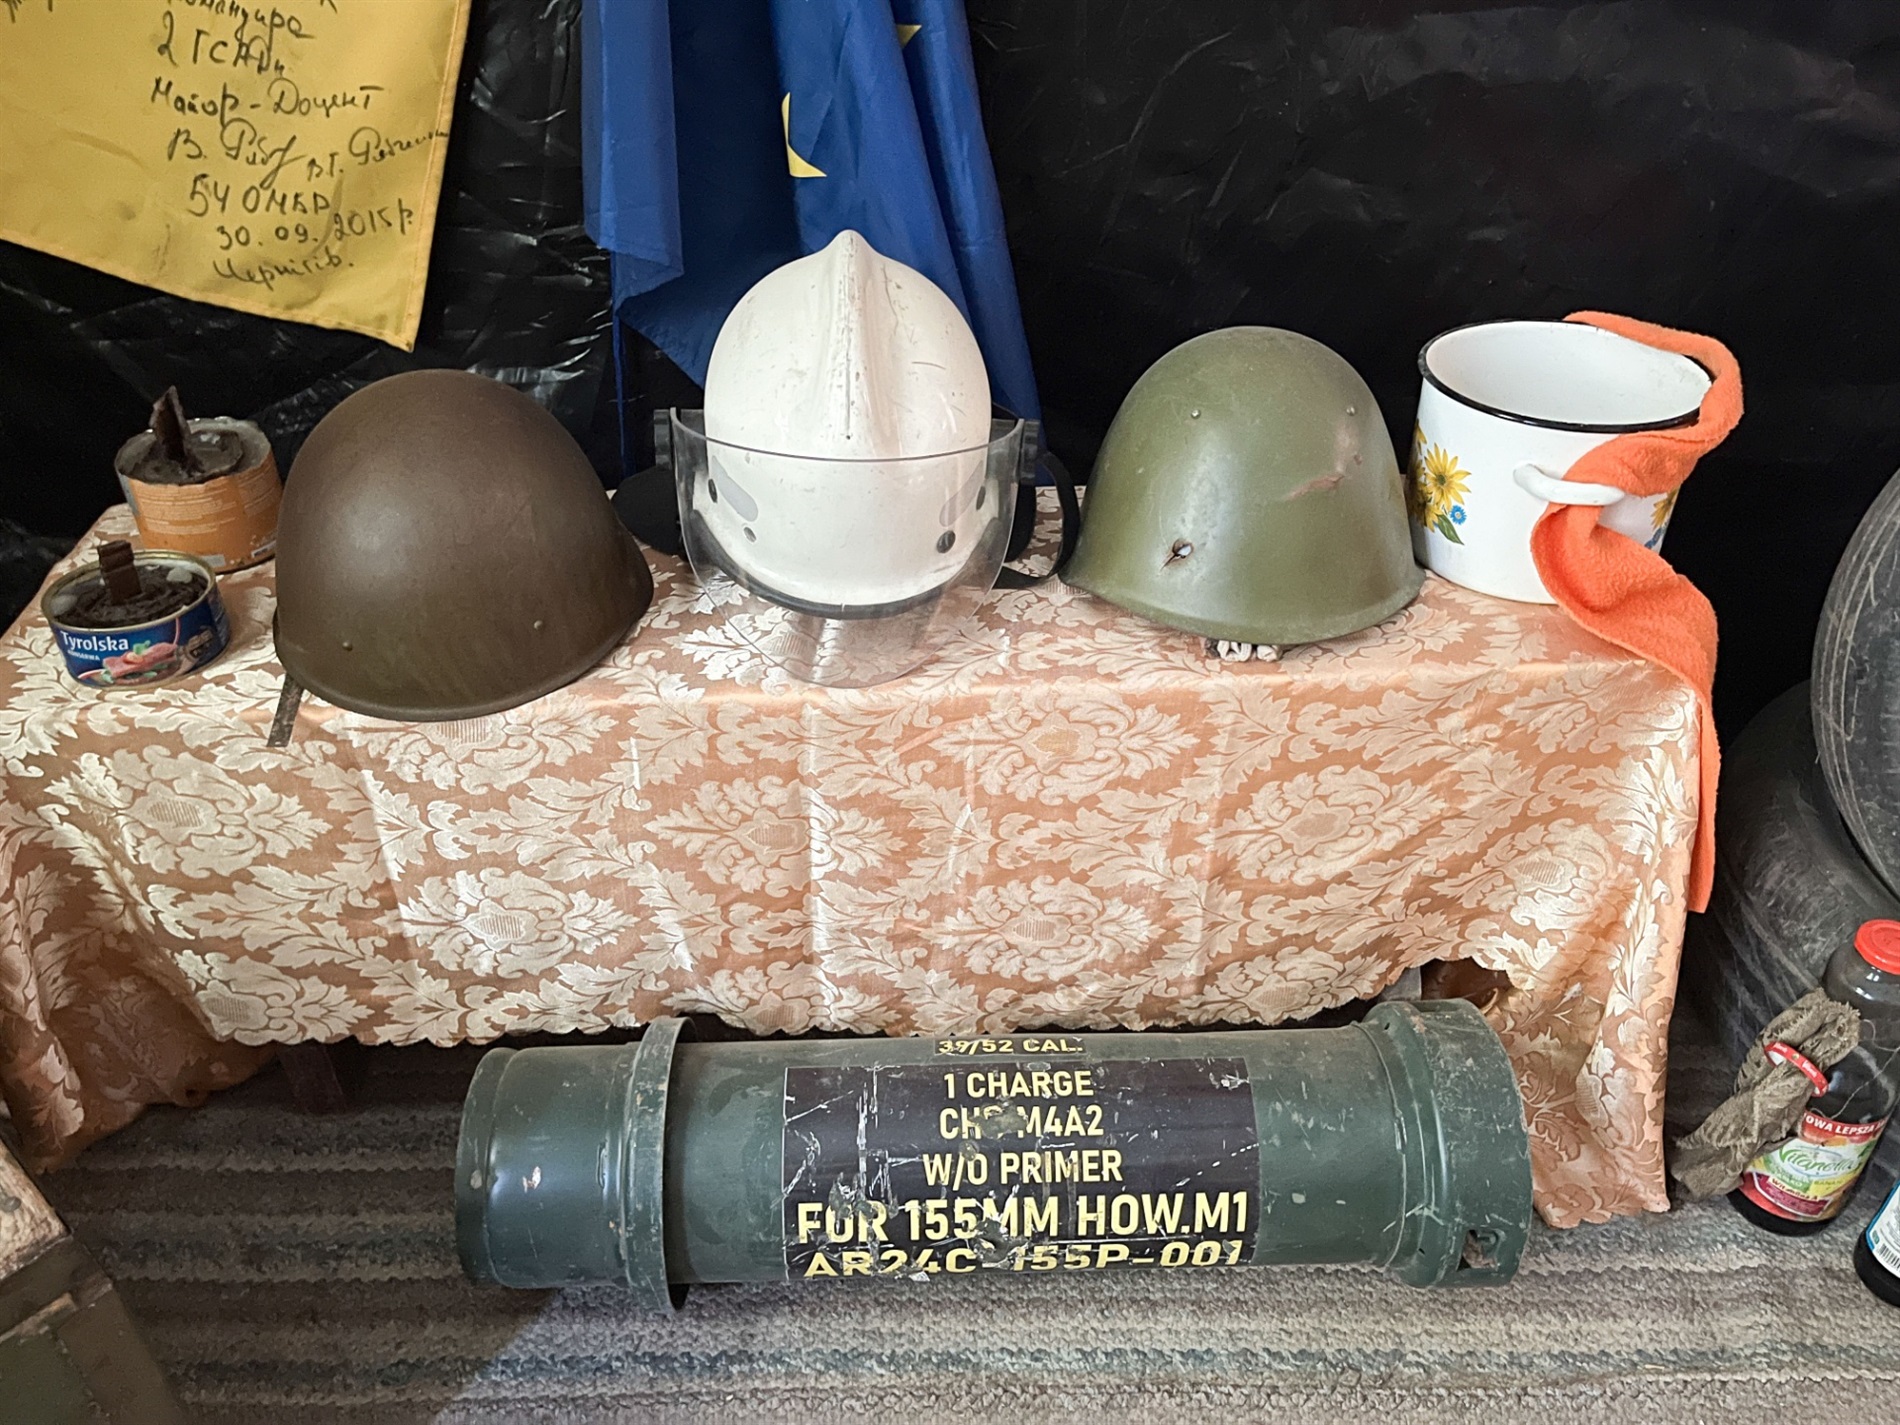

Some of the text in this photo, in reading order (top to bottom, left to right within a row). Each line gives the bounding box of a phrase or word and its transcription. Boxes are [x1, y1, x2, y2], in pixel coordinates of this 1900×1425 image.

[60, 630, 129, 652] Tyrolska
[938, 1038, 1084, 1056] 39/52 CAL.
[943, 1070, 1095, 1099] 1 CHARGE
[922, 1149, 1124, 1192] W/O PRIMER
